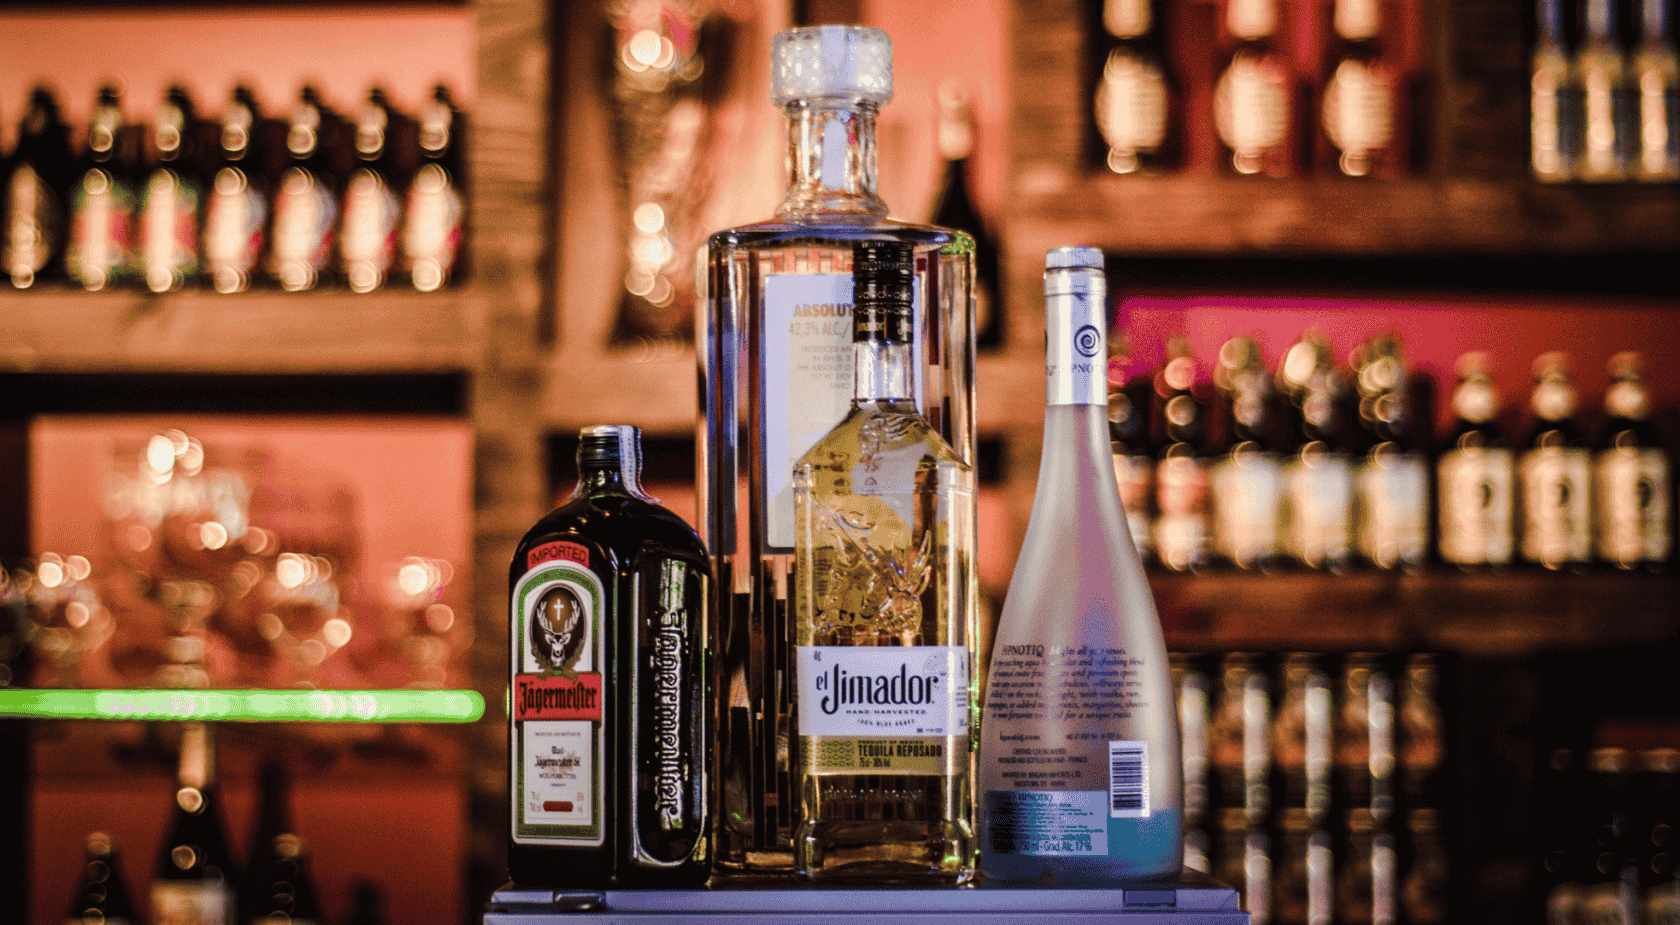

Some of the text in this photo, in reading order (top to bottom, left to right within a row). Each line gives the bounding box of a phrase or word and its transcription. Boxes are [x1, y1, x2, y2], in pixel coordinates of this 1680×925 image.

[793, 303, 854, 317] ABSOLUT
[529, 543, 588, 565] IMPORTED
[816, 670, 828, 690] el
[820, 663, 940, 715] Jimador
[858, 744, 943, 757] TEQUILA REPOSADO
